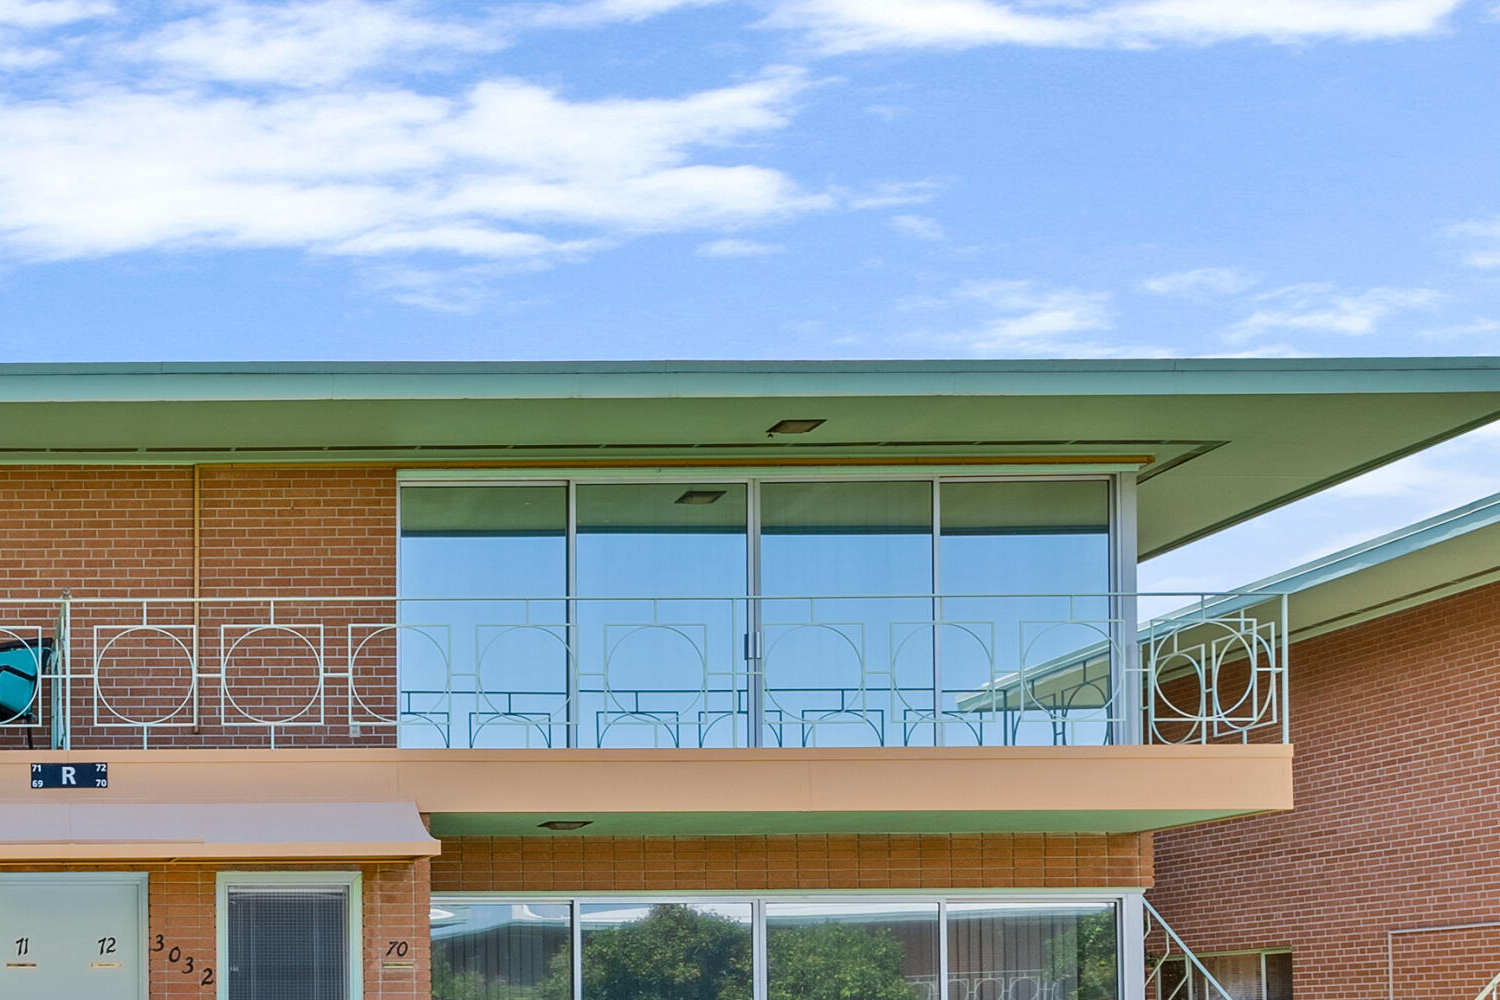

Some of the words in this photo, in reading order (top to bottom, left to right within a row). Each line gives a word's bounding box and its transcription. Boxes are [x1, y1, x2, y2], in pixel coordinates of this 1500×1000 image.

[32, 764, 41, 772] 71
[62, 766, 76, 785] R
[95, 764, 107, 772] 72
[95, 779, 107, 787] 70
[15, 937, 29, 955] 71
[98, 937, 116, 955] 72
[386, 941, 408, 957] 70
[152, 934, 214, 986] 3032
